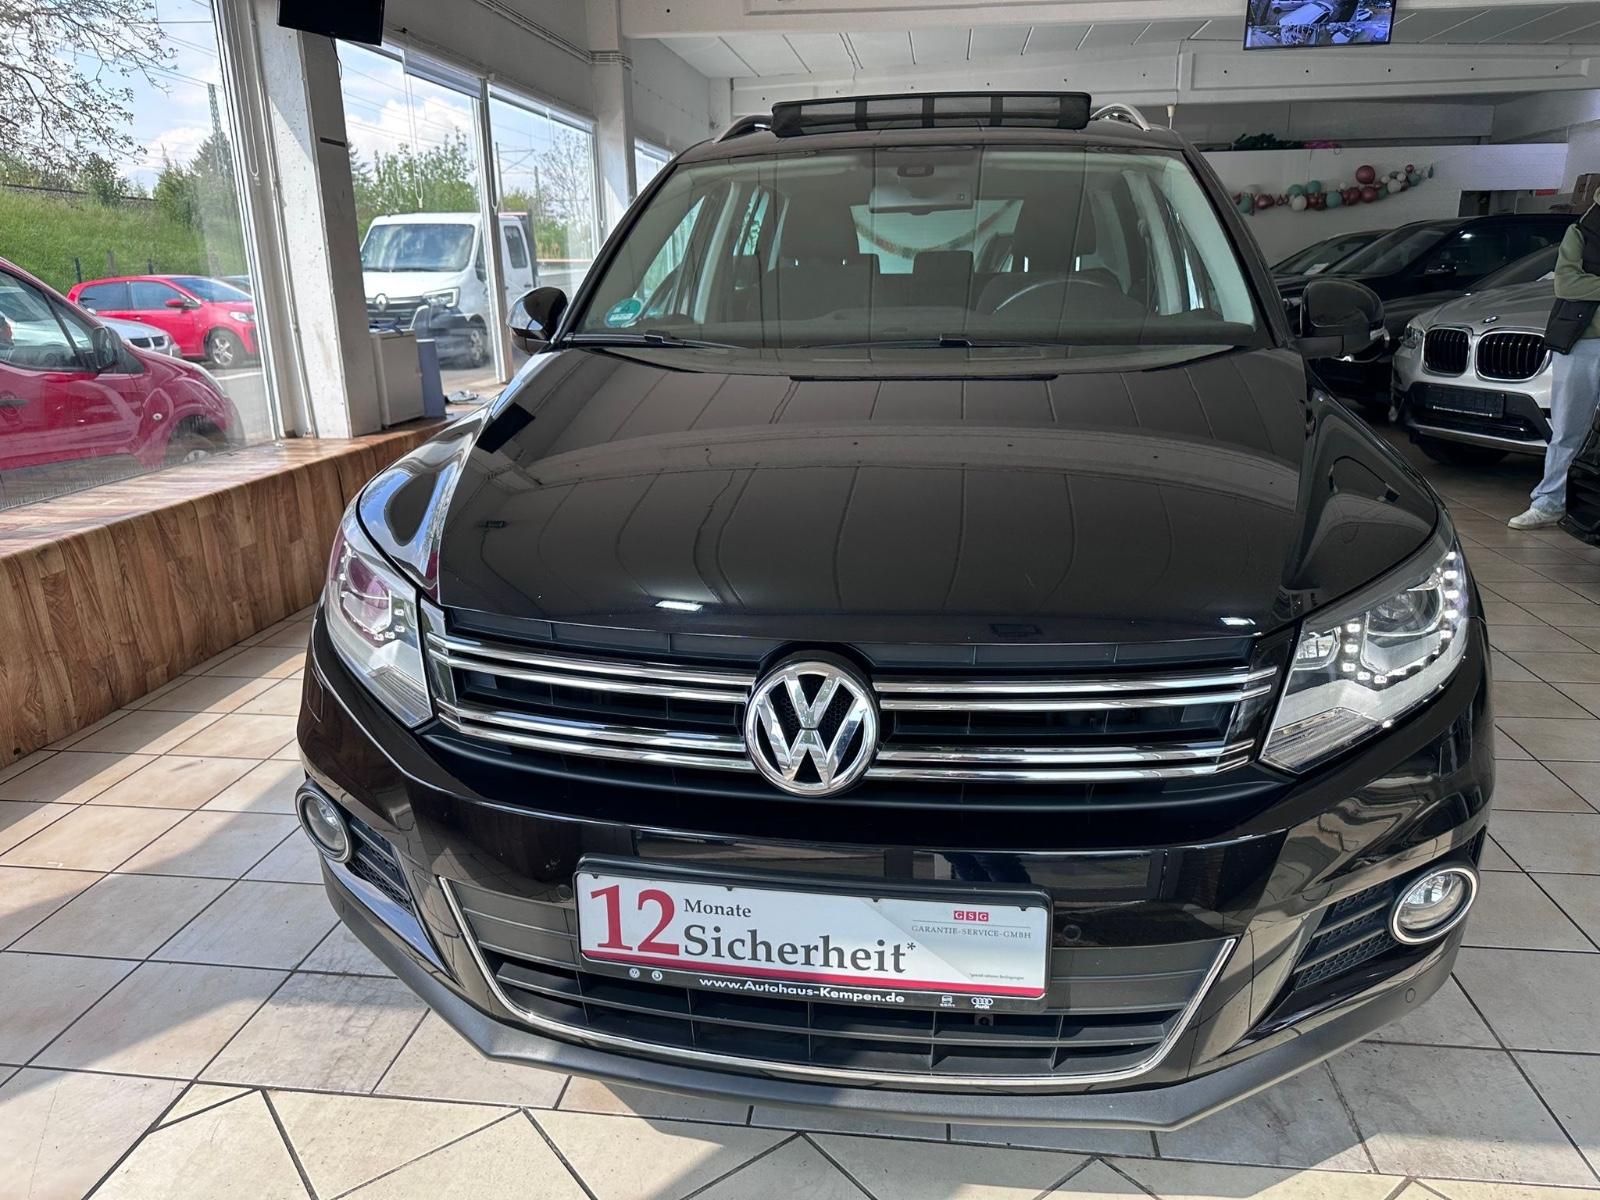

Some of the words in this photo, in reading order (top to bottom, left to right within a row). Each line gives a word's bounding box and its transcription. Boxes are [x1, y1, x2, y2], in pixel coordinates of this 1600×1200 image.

[590, 884, 680, 956] 12
[683, 898, 752, 918] Monate
[953, 910, 989, 922] GSG
[911, 925, 1032, 939] GARANTIE-SERVICE-GMBH
[699, 977, 905, 1004] www.Autohaus-Kempen.de
